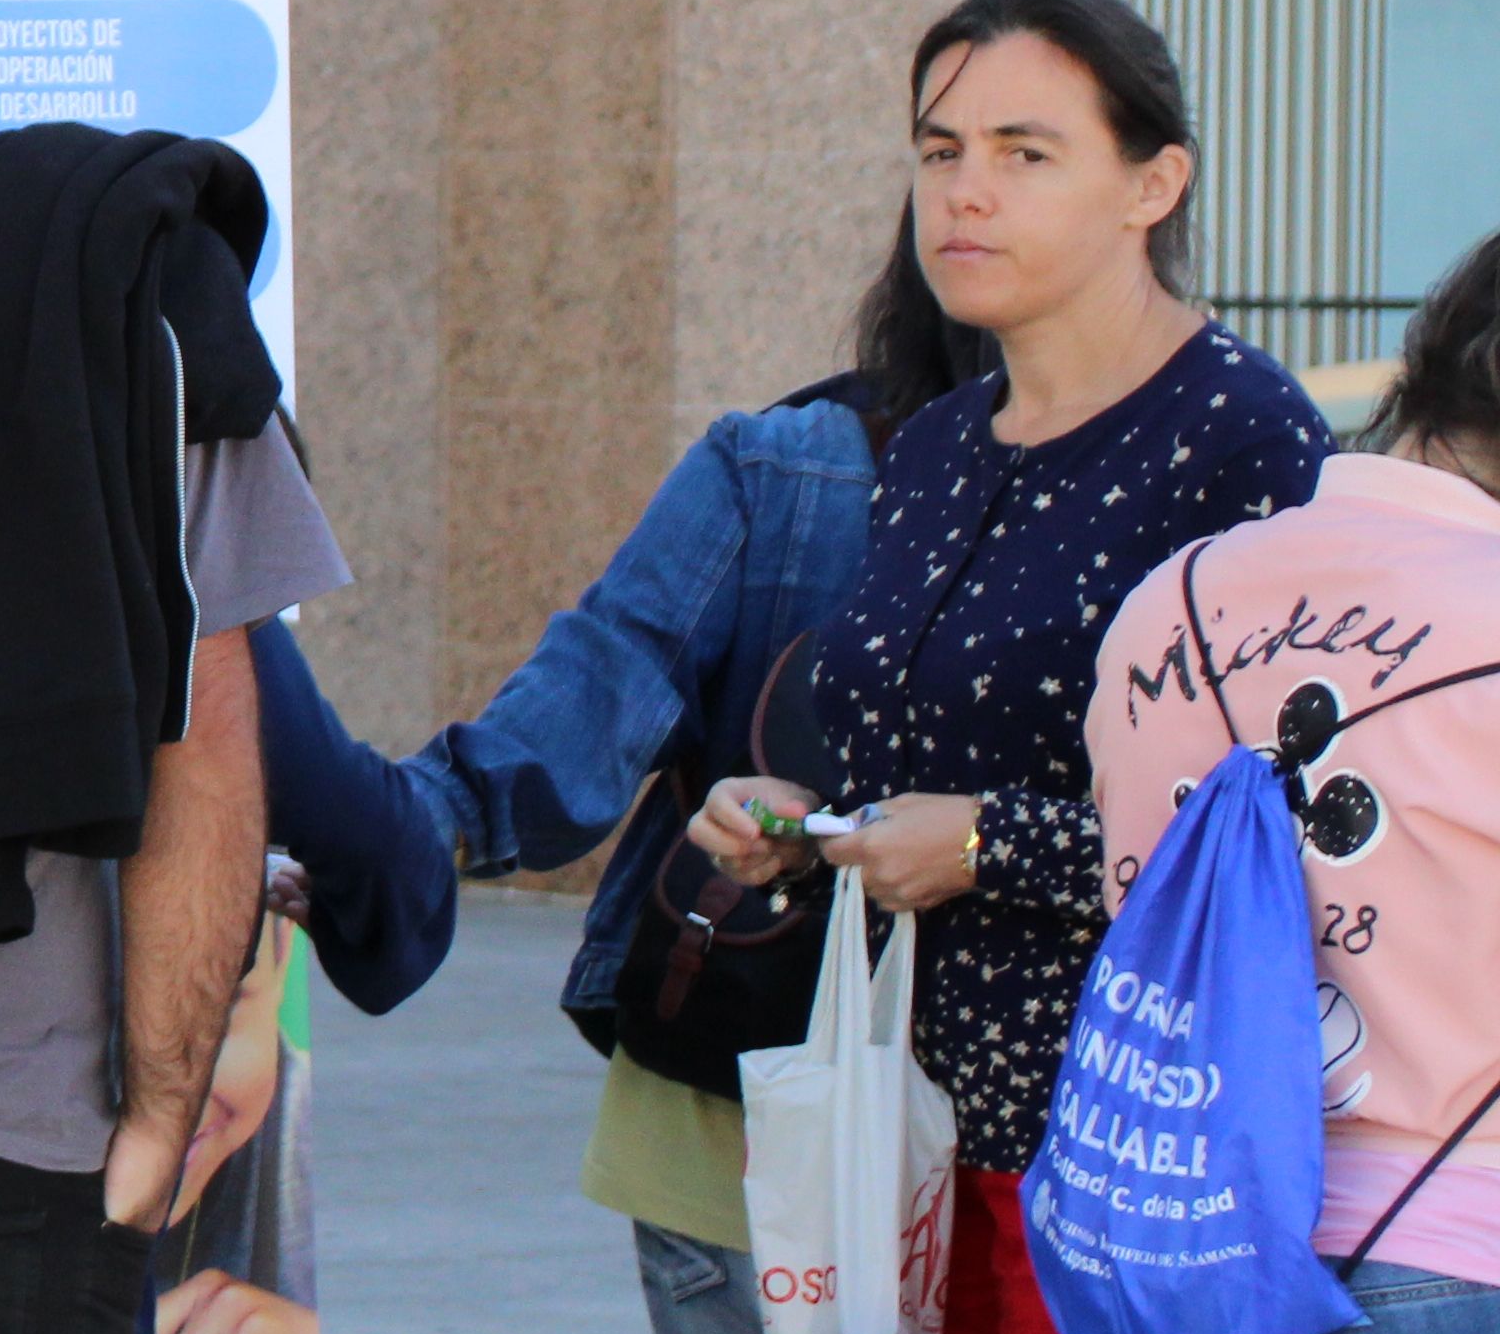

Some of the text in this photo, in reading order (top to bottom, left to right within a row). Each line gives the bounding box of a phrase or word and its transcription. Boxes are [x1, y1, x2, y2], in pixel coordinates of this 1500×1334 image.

[93, 18, 122, 47] DE
[0, 90, 137, 120] DESARROLLO
[1128, 594, 1433, 730] Mickey
[1320, 903, 1378, 955] 28
